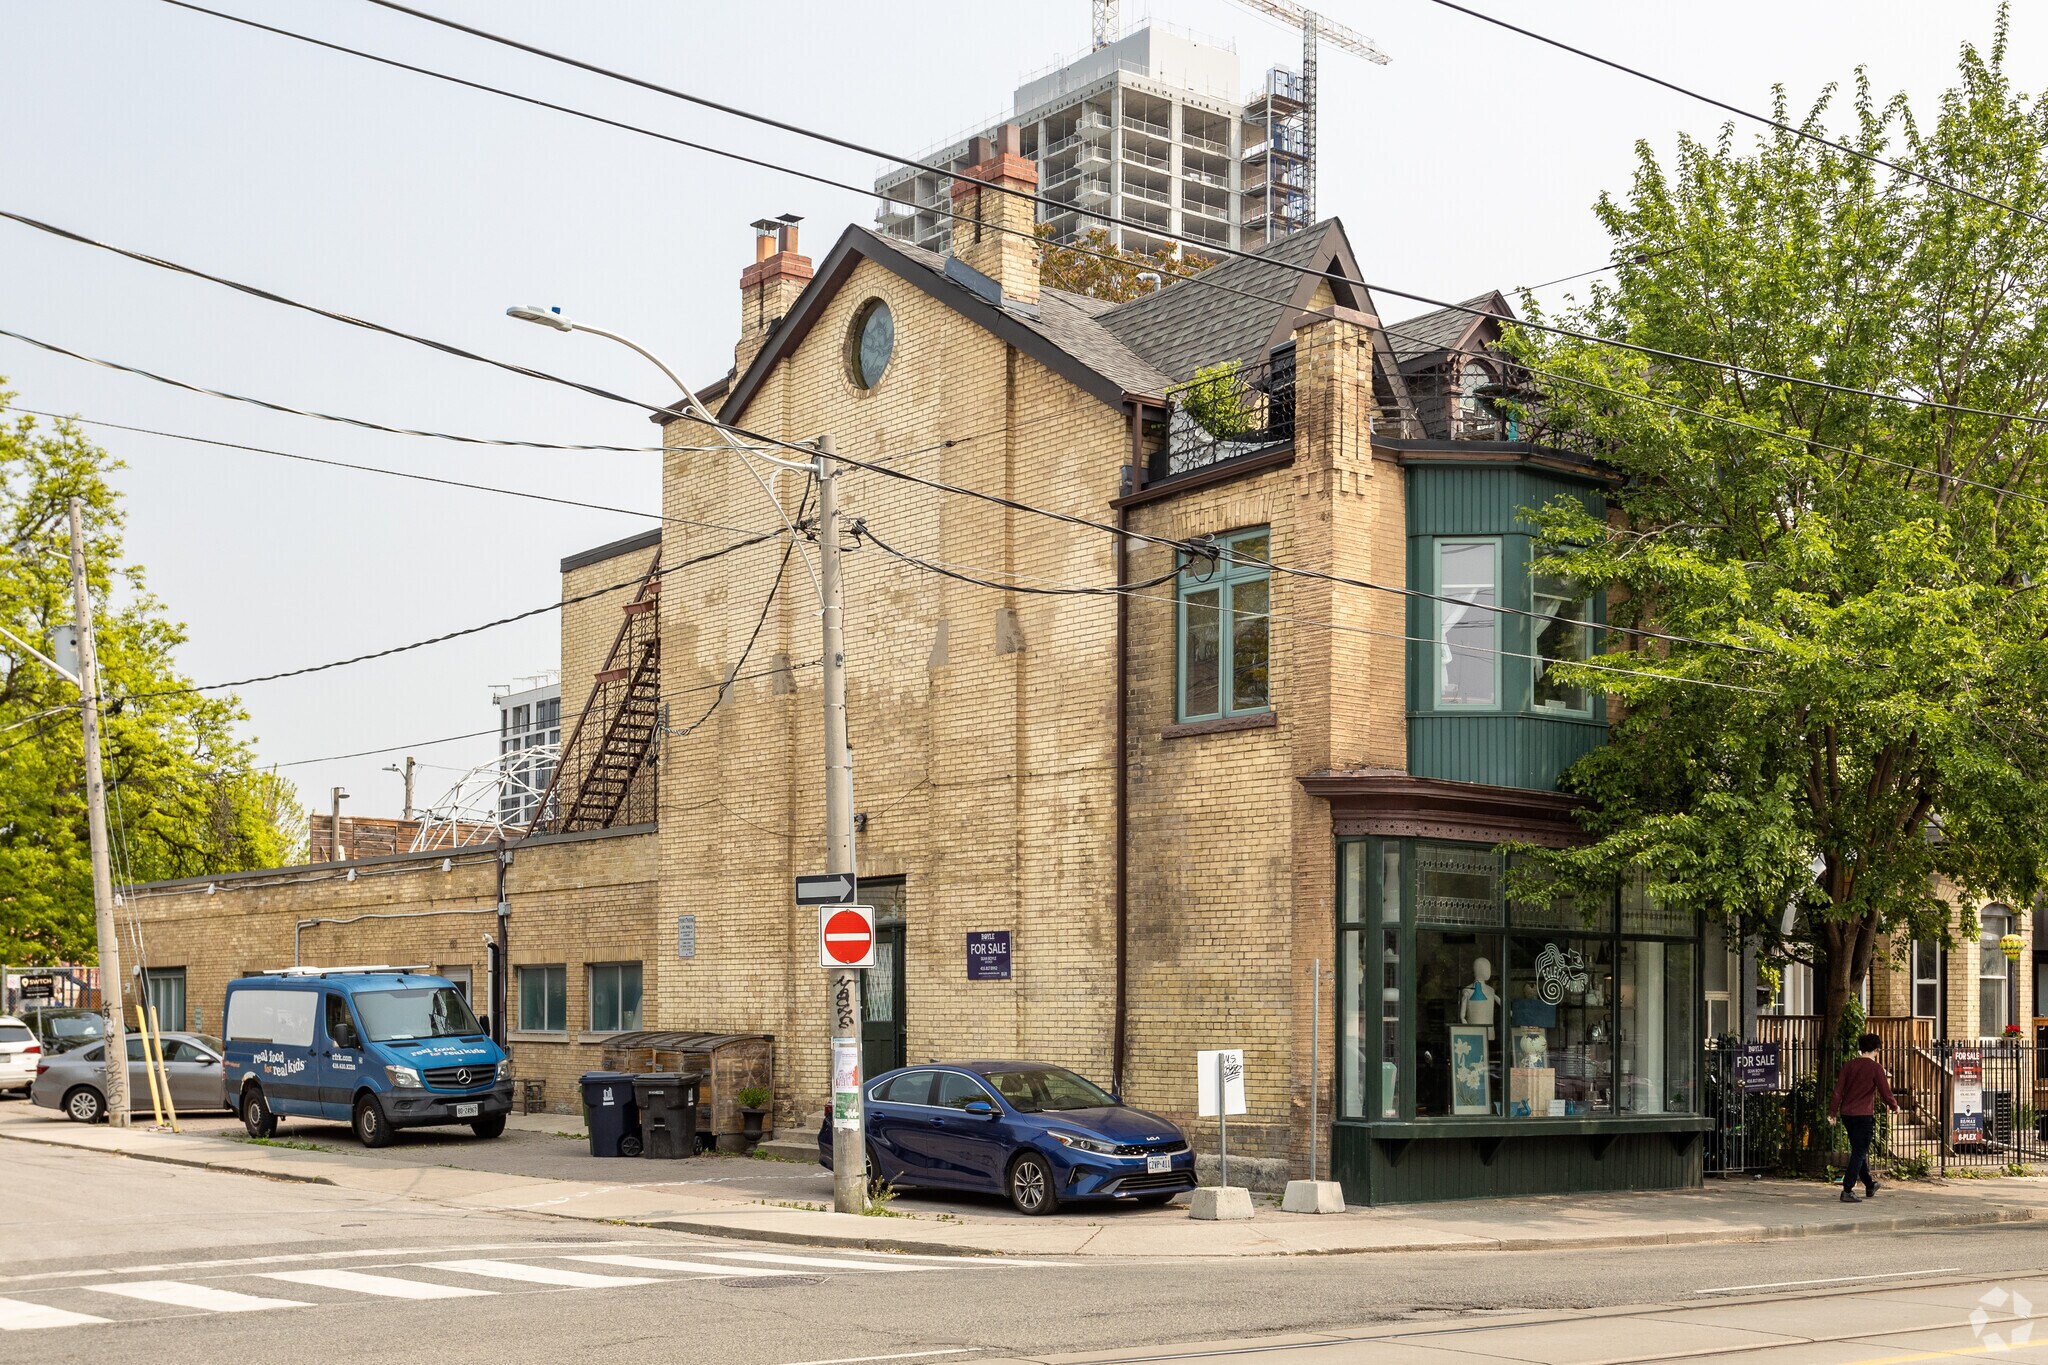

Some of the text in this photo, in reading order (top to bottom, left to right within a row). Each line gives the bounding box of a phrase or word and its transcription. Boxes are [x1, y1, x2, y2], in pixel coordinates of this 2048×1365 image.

[970, 942, 1006, 954] FOR SALE
[253, 1049, 285, 1064] real food
[410, 1046, 456, 1057] real food
[1955, 1052, 1980, 1060] FOR SALE
[264, 1057, 305, 1077] for real kids
[1736, 1054, 1775, 1068] FOR SALE
[1958, 1133, 1977, 1141] 6-PLEX
